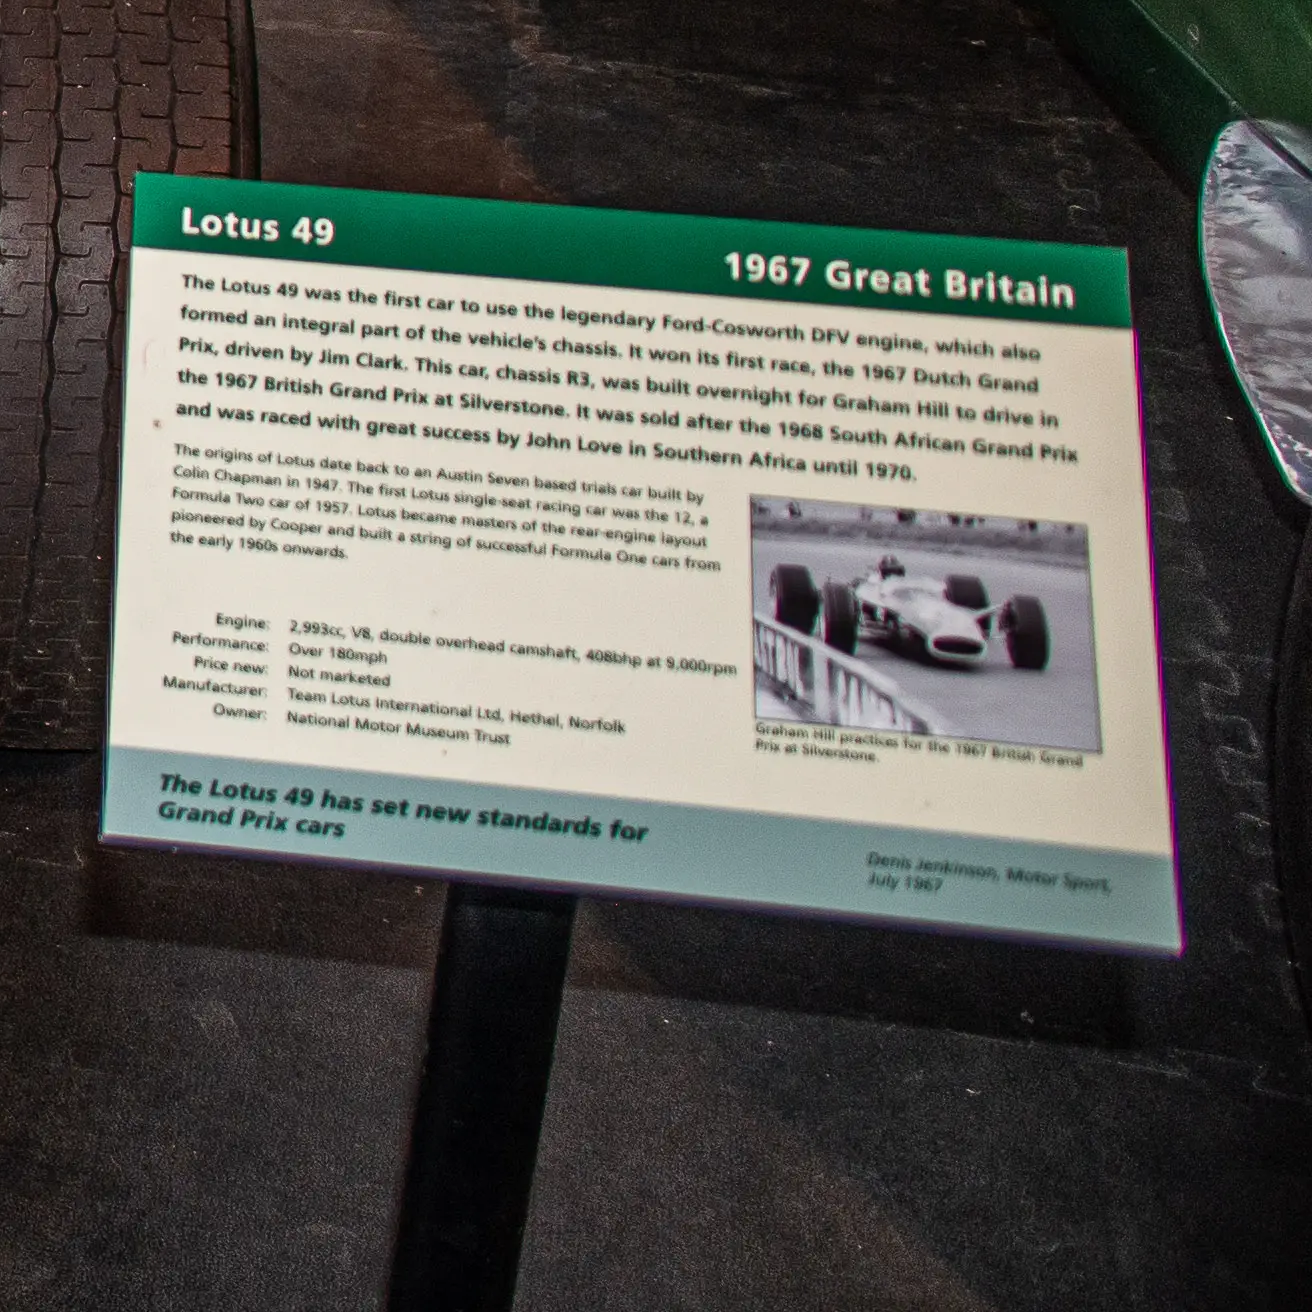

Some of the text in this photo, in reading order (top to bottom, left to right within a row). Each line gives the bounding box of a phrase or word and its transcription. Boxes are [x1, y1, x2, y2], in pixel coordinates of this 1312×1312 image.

[181, 206, 333, 245] Lotus 49
[725, 251, 1073, 308] 1967 Great Britain
[179, 303, 1039, 394] formed an integral part of the vehicle's chassis. It won its first race, the 1967 Dutch Grand
[181, 273, 1041, 361] The Lotus 49 was the first car to use the legendary Ford-Cosworth DFV engine, which also
[177, 336, 1059, 428] Prix, driven by Jim Clark. This car, chassis R3, was built overnight for Graham Hill to drive in
[175, 401, 916, 482] and was raced with great success by John Love in Southern Africa until 1970.
[176, 367, 1078, 463] the 1967 British Grand Prix at Silverstone. It was sold after the 1968 South African Grand Prix
[173, 442, 704, 506] The origins of Lotus date back to an Austin Seven based trials car built by
[171, 630, 387, 665] Performance: Over 180mph
[193, 655, 391, 688] Price new: Not marketed
[215, 611, 737, 677] Engine: 2,993cc, V8, double overhead camshaft, 408bhp at 9,000rpm
[161, 674, 625, 734] Manufacturer: Team Lotus International Ltd, Hethel, Norfolk
[212, 702, 510, 746] Owner: National Motor Museum Trust
[157, 800, 345, 838] Grand Prix cars
[160, 772, 649, 843] The Lotus 49 has set new standards for
